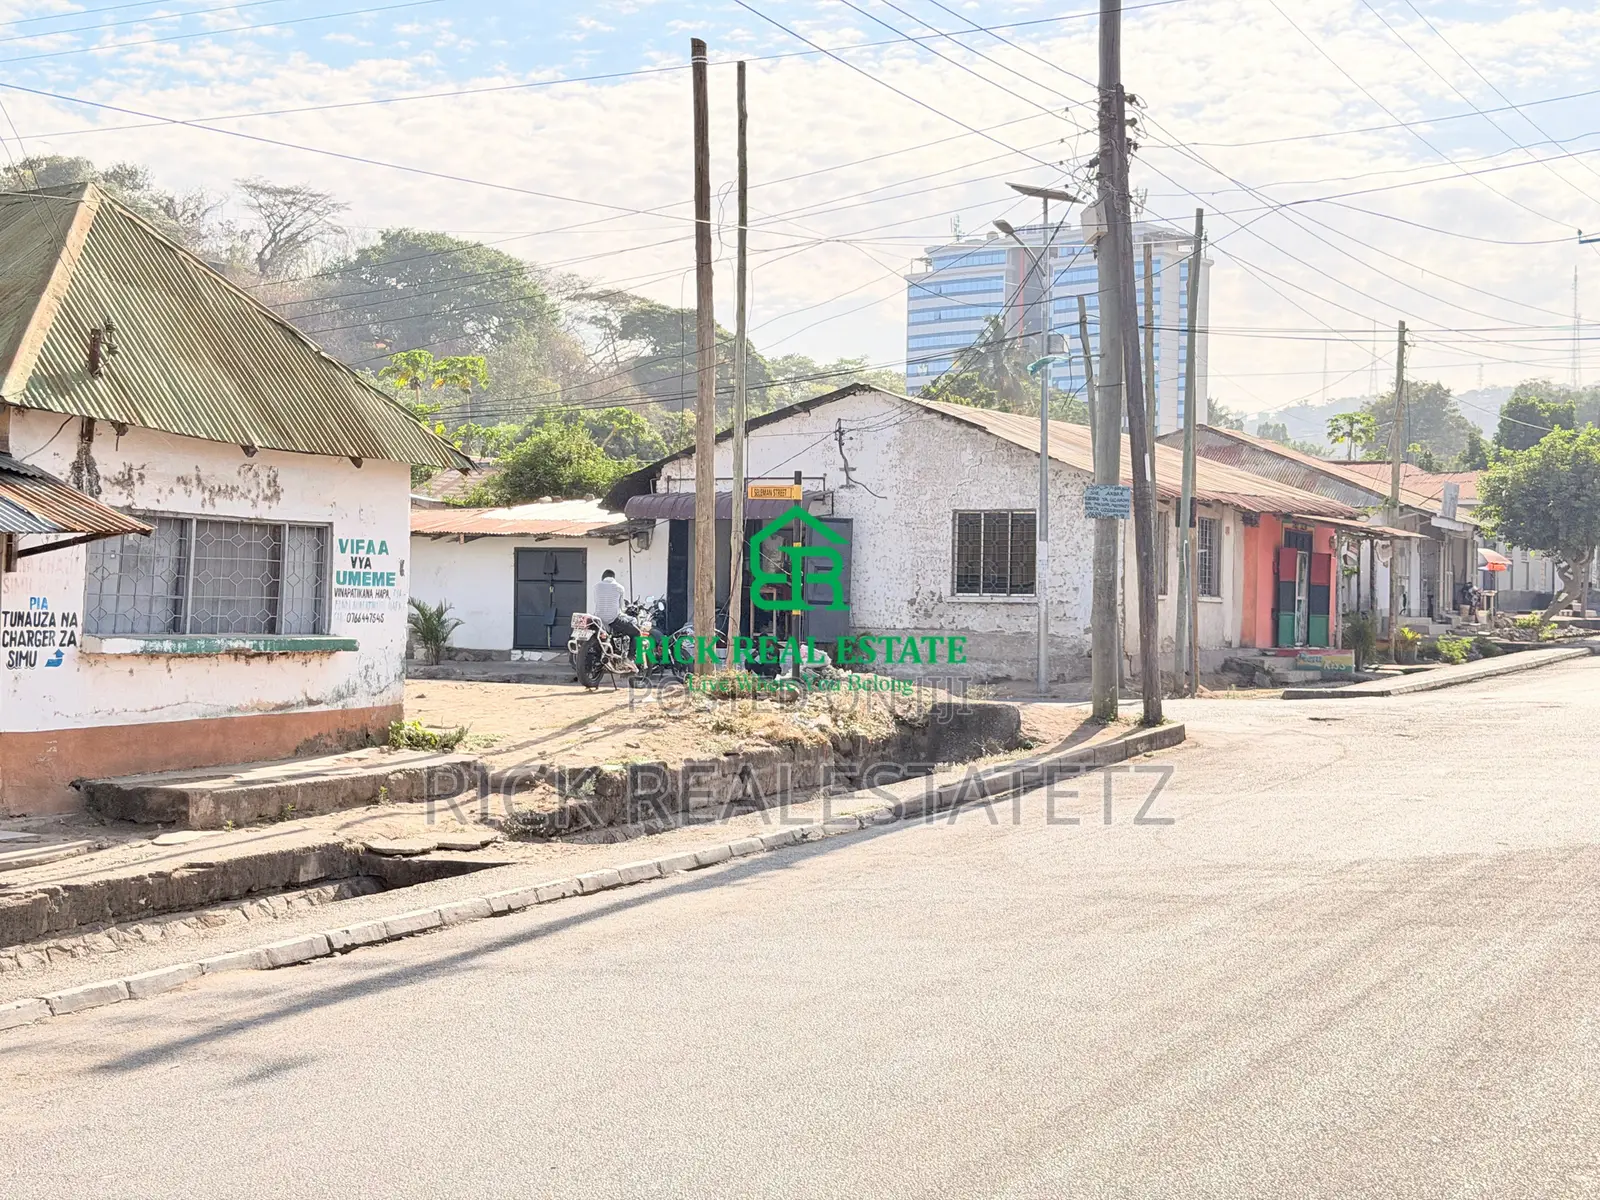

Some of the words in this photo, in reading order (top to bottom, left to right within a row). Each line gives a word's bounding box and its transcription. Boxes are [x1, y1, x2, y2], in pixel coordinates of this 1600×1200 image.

[773, 489, 787, 497] STREET
[338, 538, 389, 555] VIFAA
[351, 556, 372, 569] VYA
[336, 570, 396, 587] UMEME
[334, 588, 373, 599] VINAPATIKANA
[30, 597, 48, 610] PIA
[2, 611, 56, 627] TUNAUZA
[61, 612, 78, 627] NA
[2, 630, 55, 647] CHARGER
[59, 631, 77, 647] ZA
[7, 650, 37, 669] SIMU
